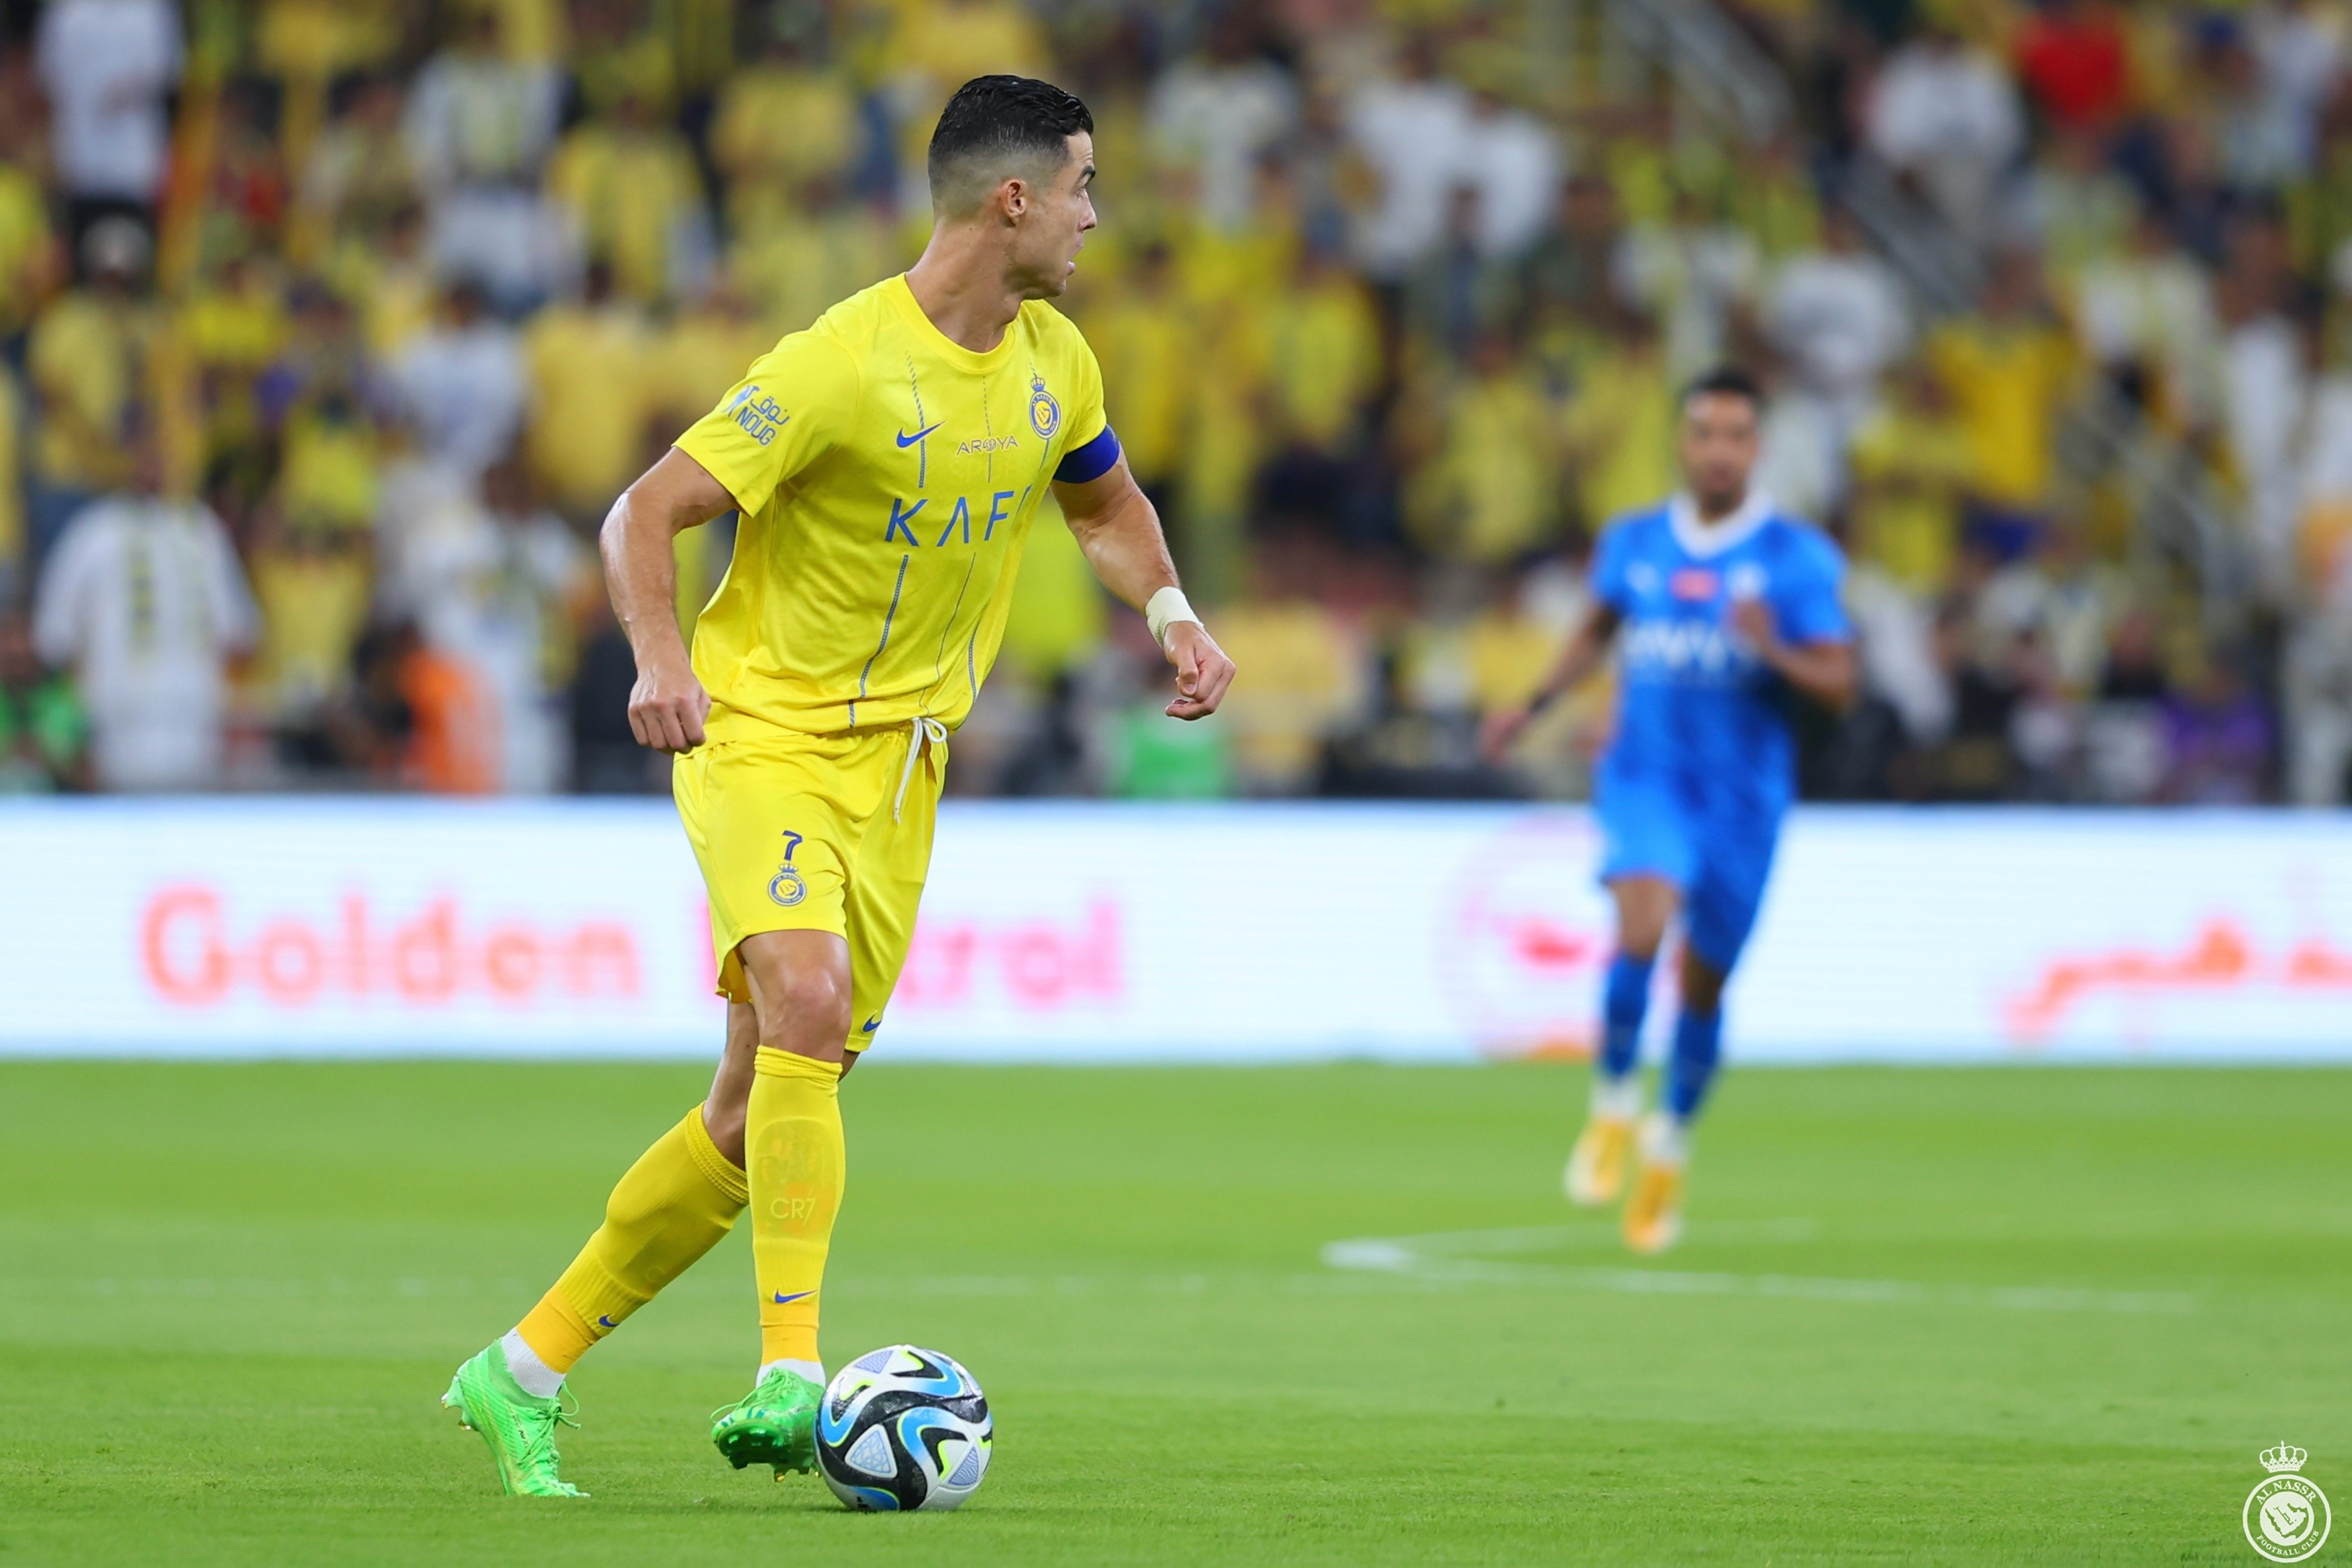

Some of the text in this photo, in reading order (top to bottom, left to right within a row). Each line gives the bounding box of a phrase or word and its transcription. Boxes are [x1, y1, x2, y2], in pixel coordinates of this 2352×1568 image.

[735, 406, 776, 446] NOUG
[749, 396, 790, 426] نوق
[956, 436, 1018, 456] AROYA
[885, 484, 1032, 547] KAF
[782, 829, 803, 861] 7
[137, 884, 642, 1008] Golden
[770, 1184, 816, 1228] CR7
